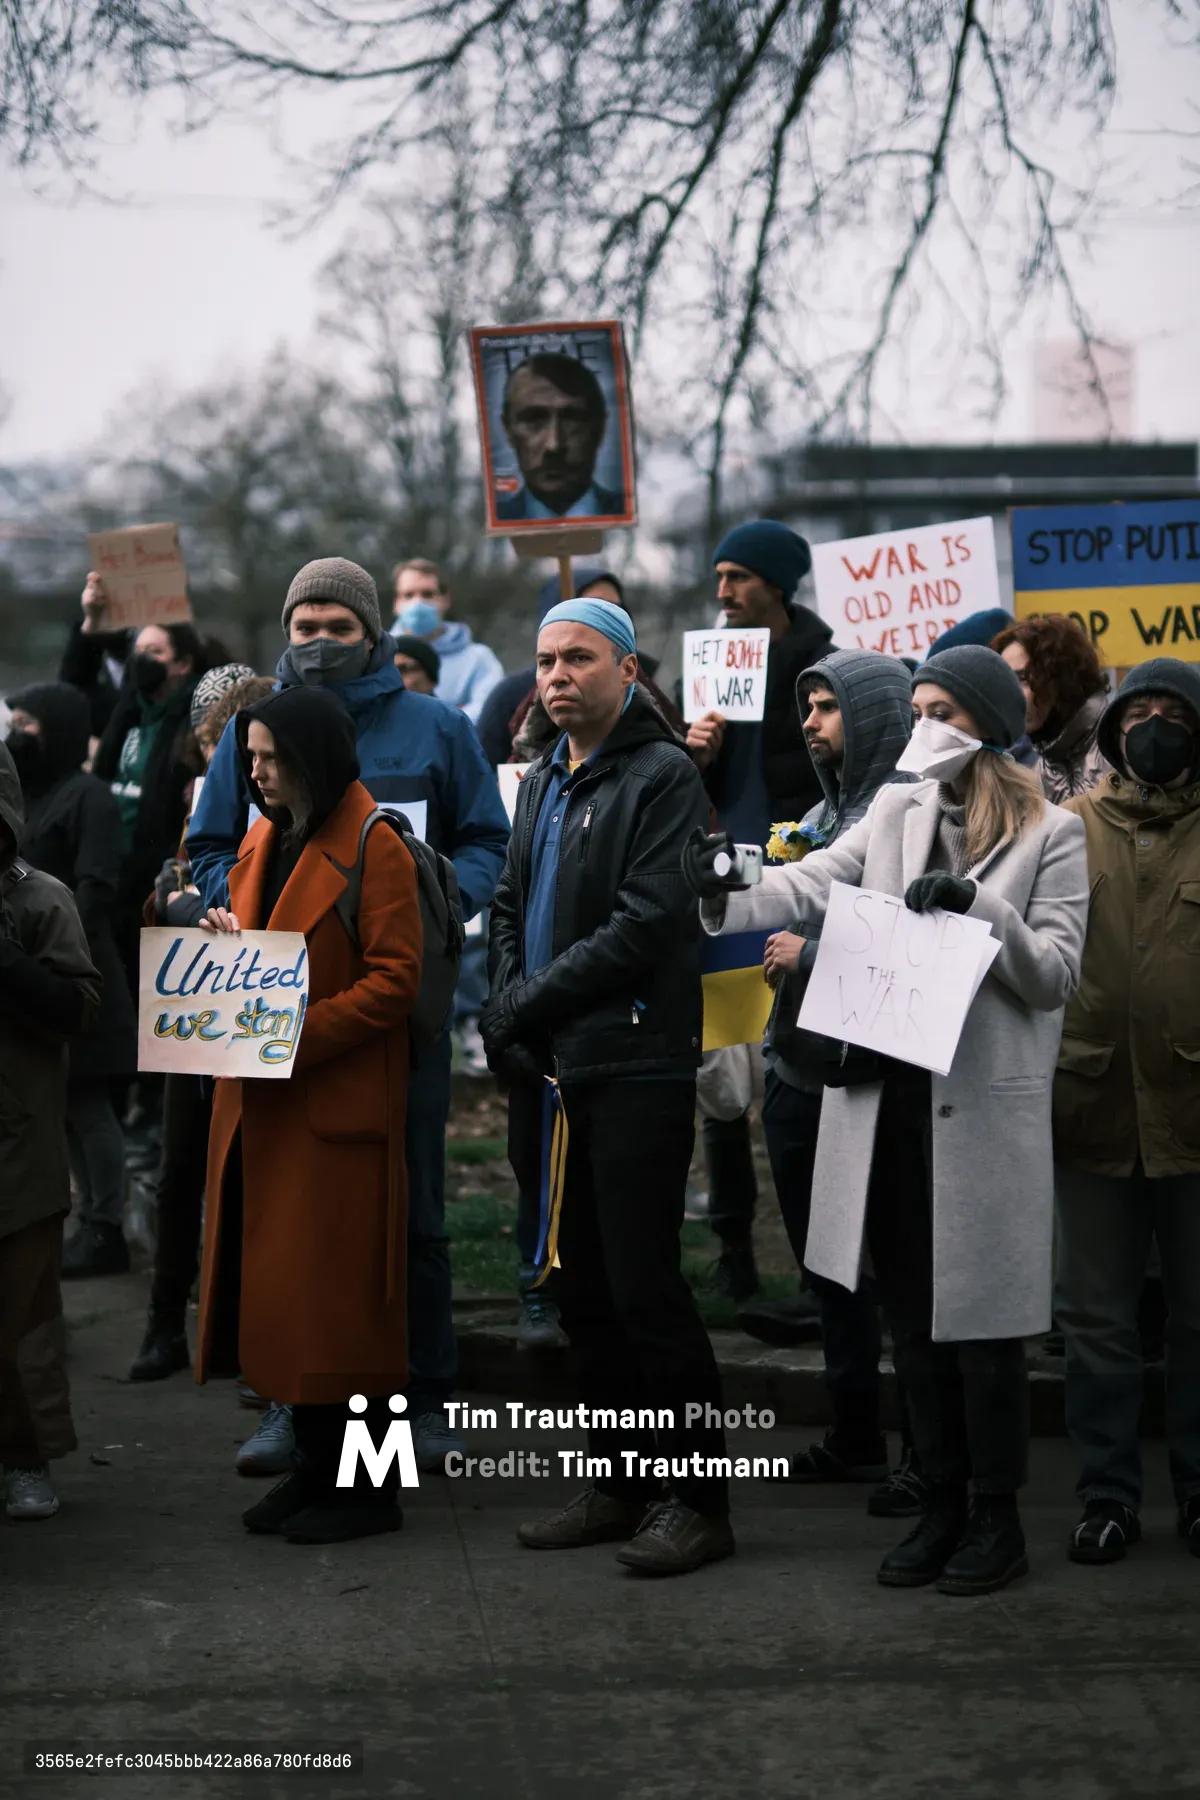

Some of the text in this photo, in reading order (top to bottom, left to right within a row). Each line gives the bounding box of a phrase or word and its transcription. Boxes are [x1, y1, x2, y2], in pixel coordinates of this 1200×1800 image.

[483, 341, 602, 376] TE
[840, 533, 972, 582] WAR IS
[1028, 525, 1113, 565] STOP
[844, 578, 962, 624] OLD AND
[692, 639, 722, 665] НЕТ
[692, 675, 754, 708] NO WAR
[842, 894, 966, 973] STOP
[155, 937, 307, 997] United
[867, 965, 898, 986] THE
[153, 1008, 228, 1041] we
[838, 975, 928, 1048] WAR
